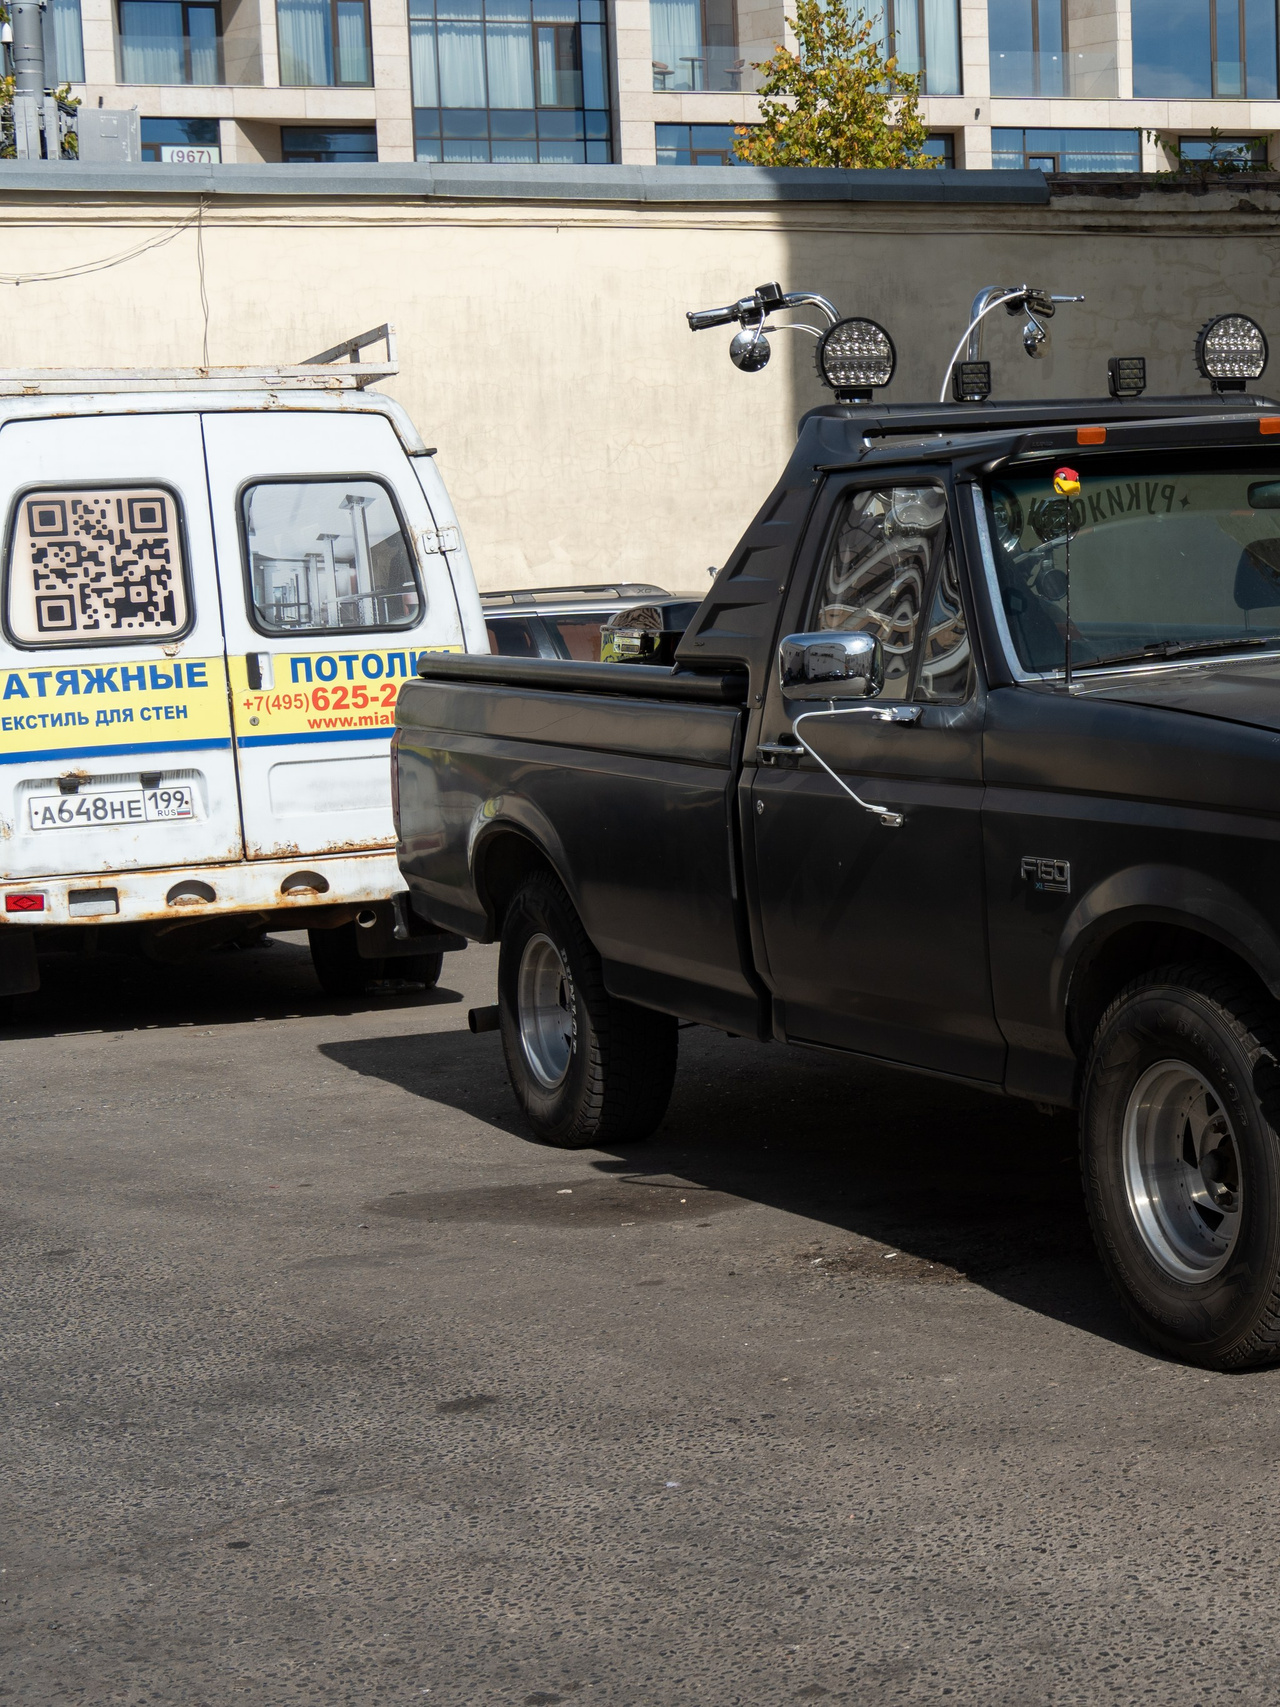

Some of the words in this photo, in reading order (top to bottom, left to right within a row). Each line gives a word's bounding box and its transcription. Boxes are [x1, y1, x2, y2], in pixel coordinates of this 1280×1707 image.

[170, 150, 212, 163] (967)
[3, 662, 208, 700] АТЯЖНЫЕ
[290, 650, 450, 683] ПОТОЛК
[1, 711, 90, 732] ЕКСТИЛЬ
[95, 708, 134, 727] ДЛЯ
[139, 705, 188, 721] СТЕН
[148, 791, 185, 810] 199
[157, 809, 177, 817] RUS
